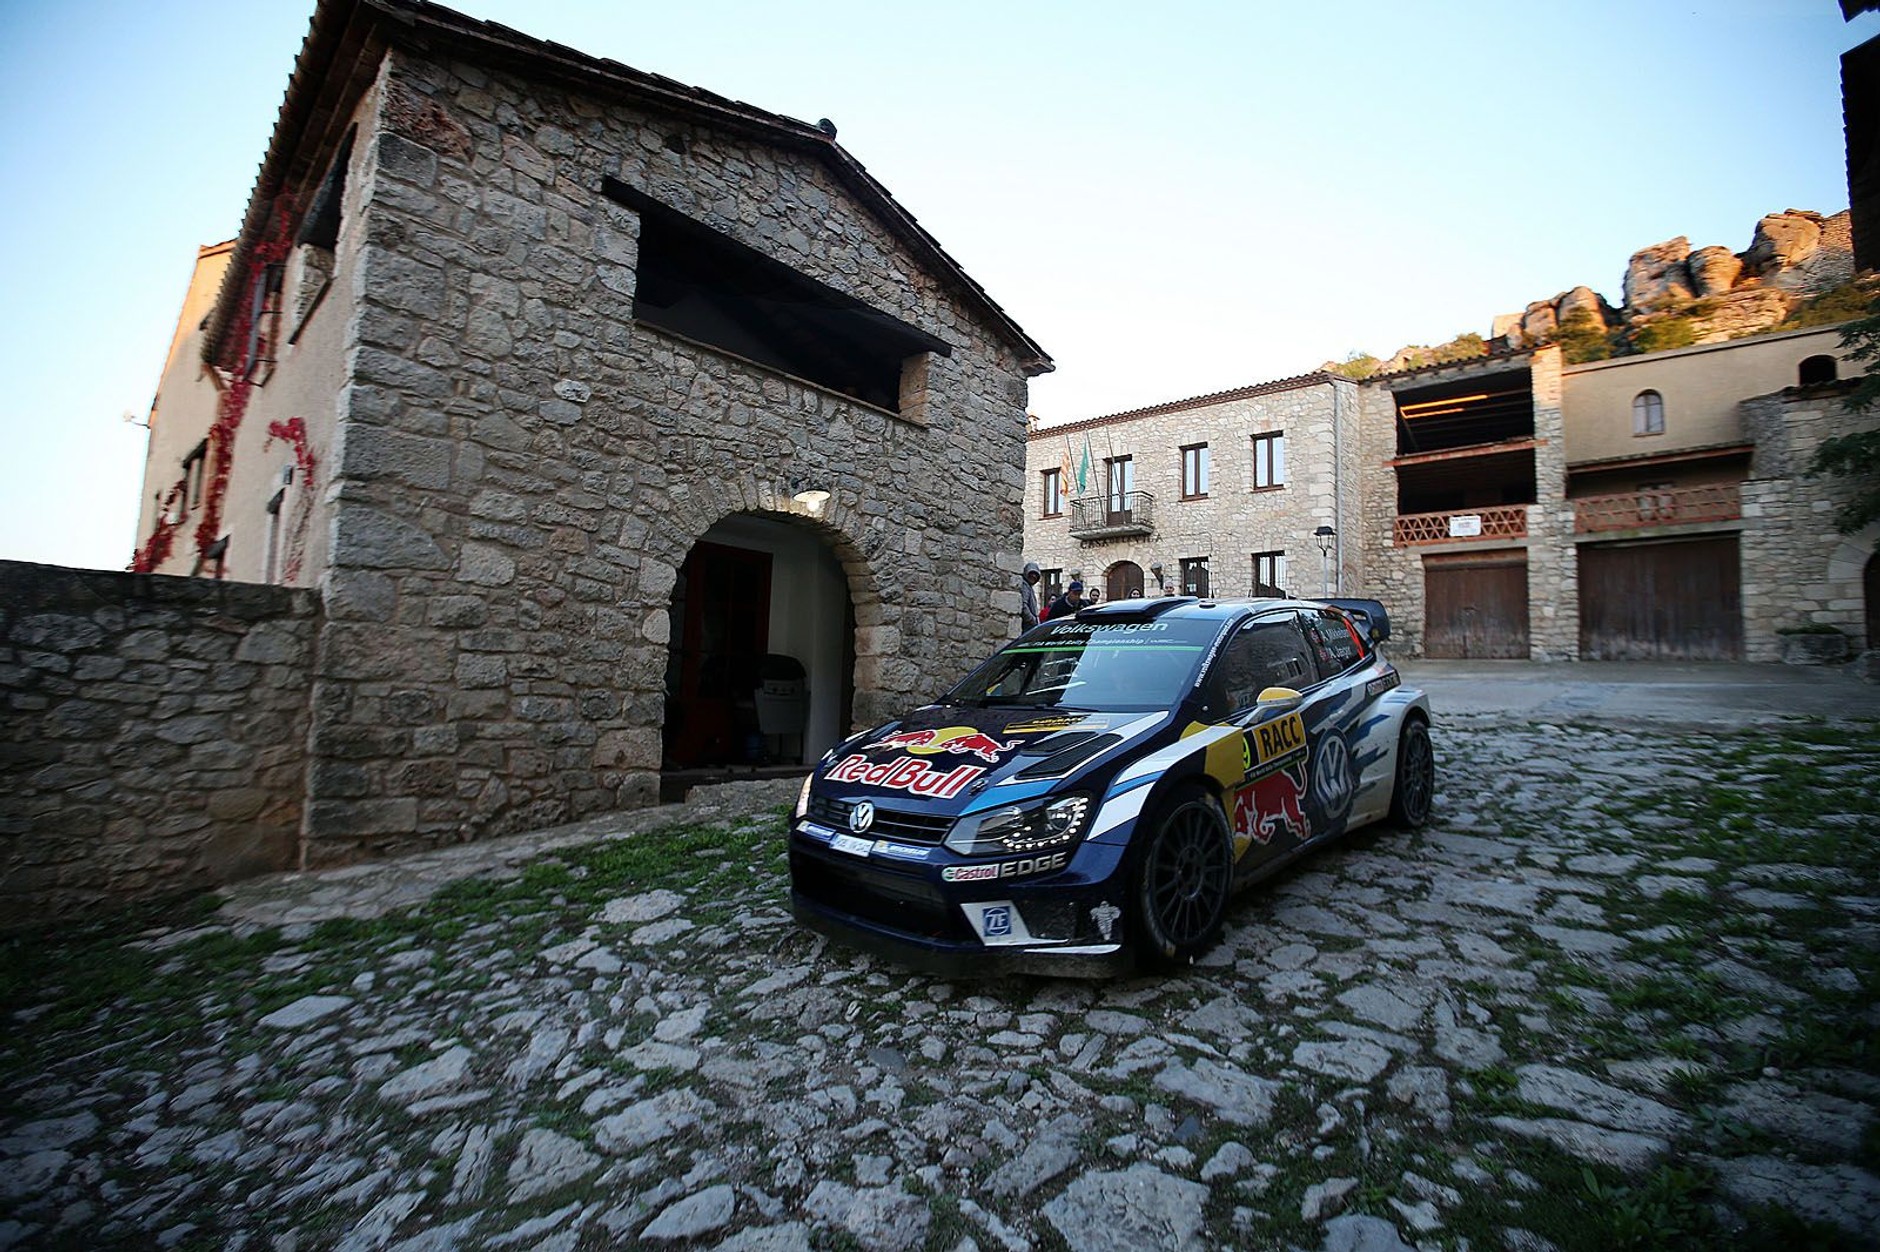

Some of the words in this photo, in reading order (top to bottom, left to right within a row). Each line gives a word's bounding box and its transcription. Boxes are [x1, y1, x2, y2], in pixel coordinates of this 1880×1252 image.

[1051, 623, 1168, 635] Volkswagen
[1260, 716, 1300, 758] RACC
[827, 755, 908, 785] Red
[882, 759, 985, 798] Bull
[955, 866, 997, 880] Castrol
[1001, 852, 1066, 877] EDGE
